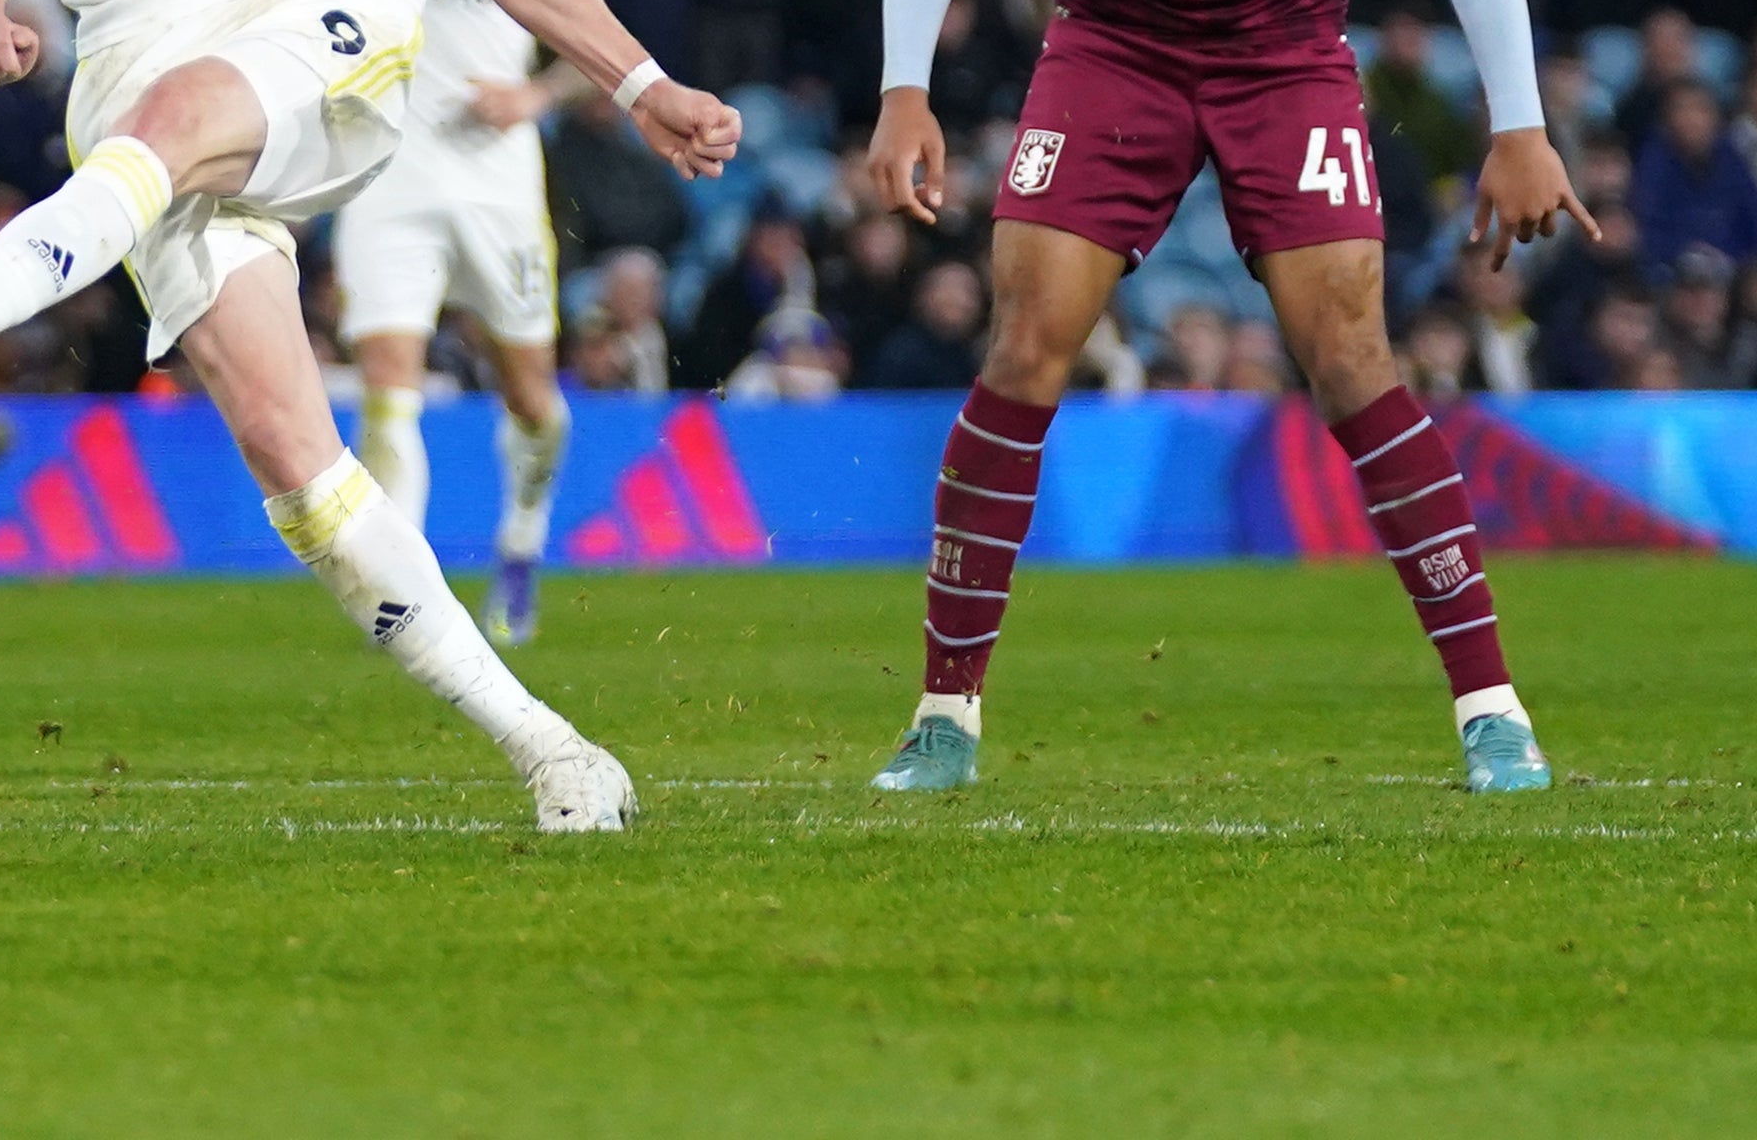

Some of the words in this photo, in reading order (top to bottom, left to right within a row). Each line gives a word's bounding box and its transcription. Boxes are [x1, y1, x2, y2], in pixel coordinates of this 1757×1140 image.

[321, 9, 367, 56] 9
[1024, 132, 1060, 148] AVFC
[1297, 126, 1371, 207] 41
[27, 238, 64, 294] adidas
[1427, 559, 1470, 591] VILLA
[377, 602, 423, 647] adidas
